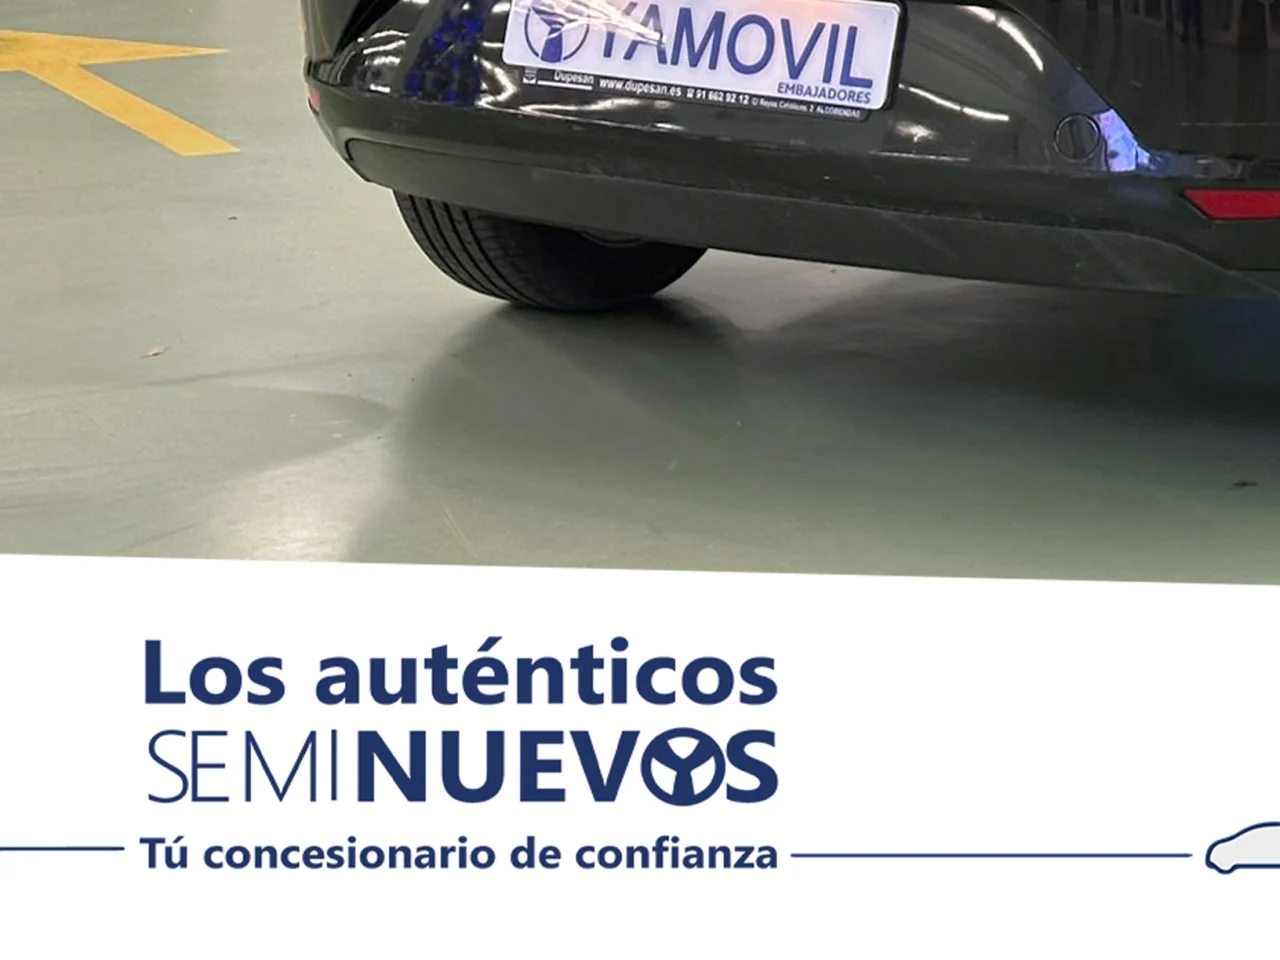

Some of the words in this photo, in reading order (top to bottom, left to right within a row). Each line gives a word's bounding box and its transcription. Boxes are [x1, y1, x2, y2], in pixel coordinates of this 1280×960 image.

[602, 0, 874, 89] YAMOVIL
[553, 70, 595, 85] Dupesan
[599, 76, 682, 97] www.dupesan.es
[776, 81, 872, 105] EMBAJADORES
